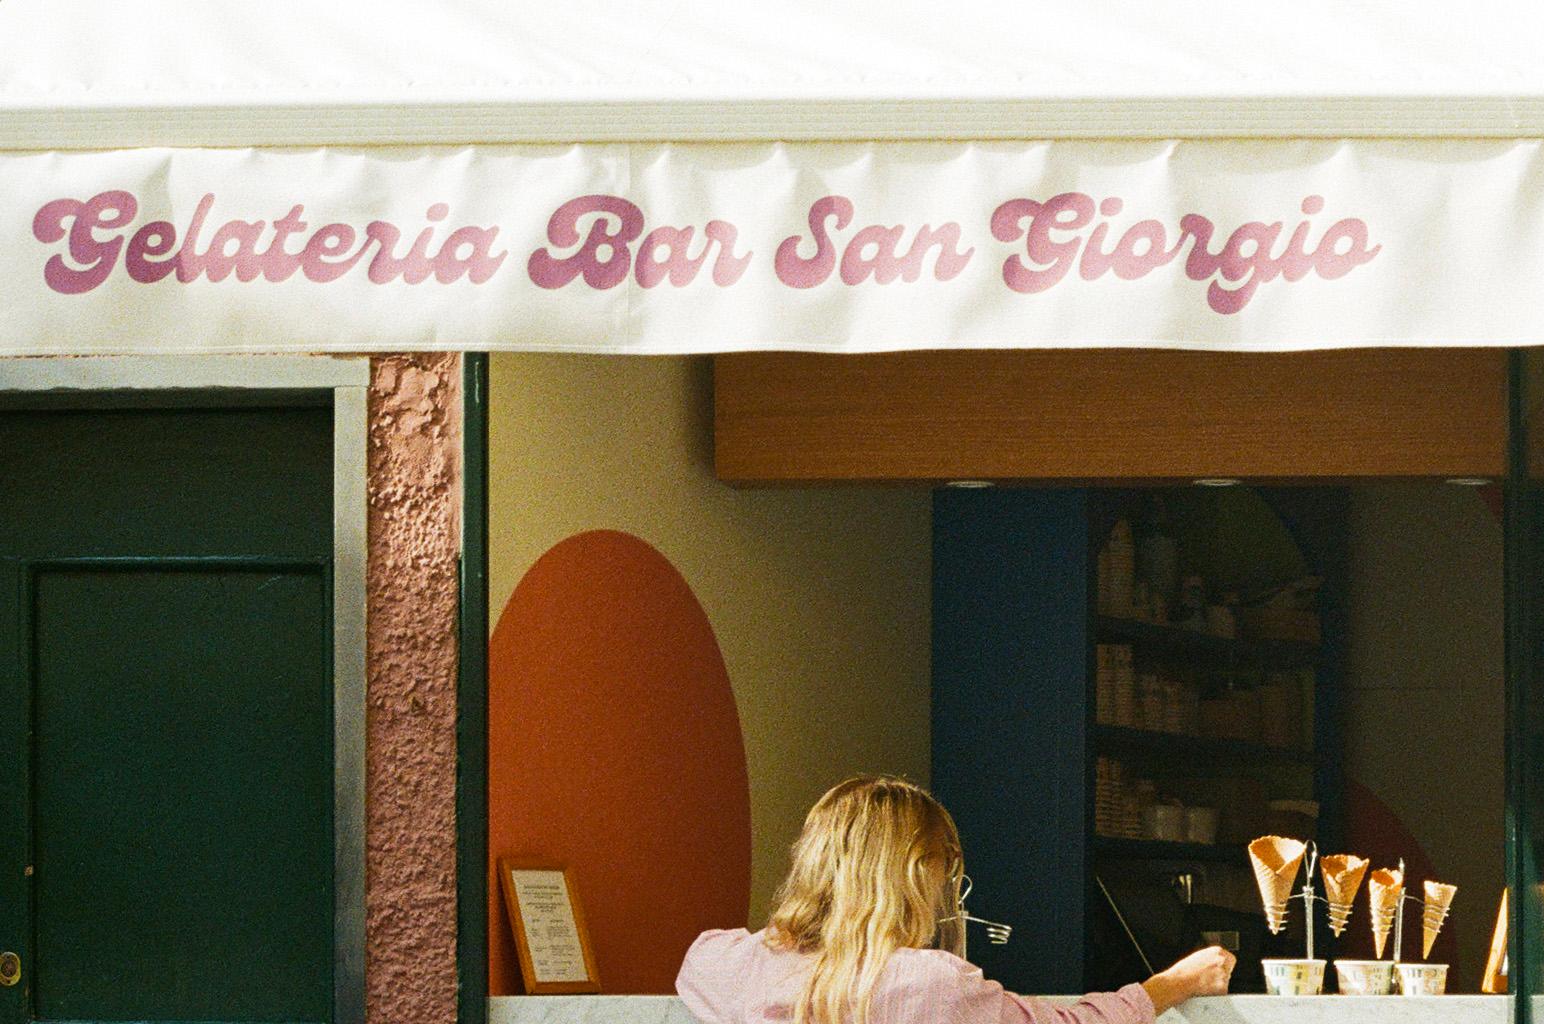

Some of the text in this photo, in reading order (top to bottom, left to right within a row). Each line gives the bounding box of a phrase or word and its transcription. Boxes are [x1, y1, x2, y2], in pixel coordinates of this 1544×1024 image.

[32, 189, 1382, 315] Gelateria Bar San Giorgio
